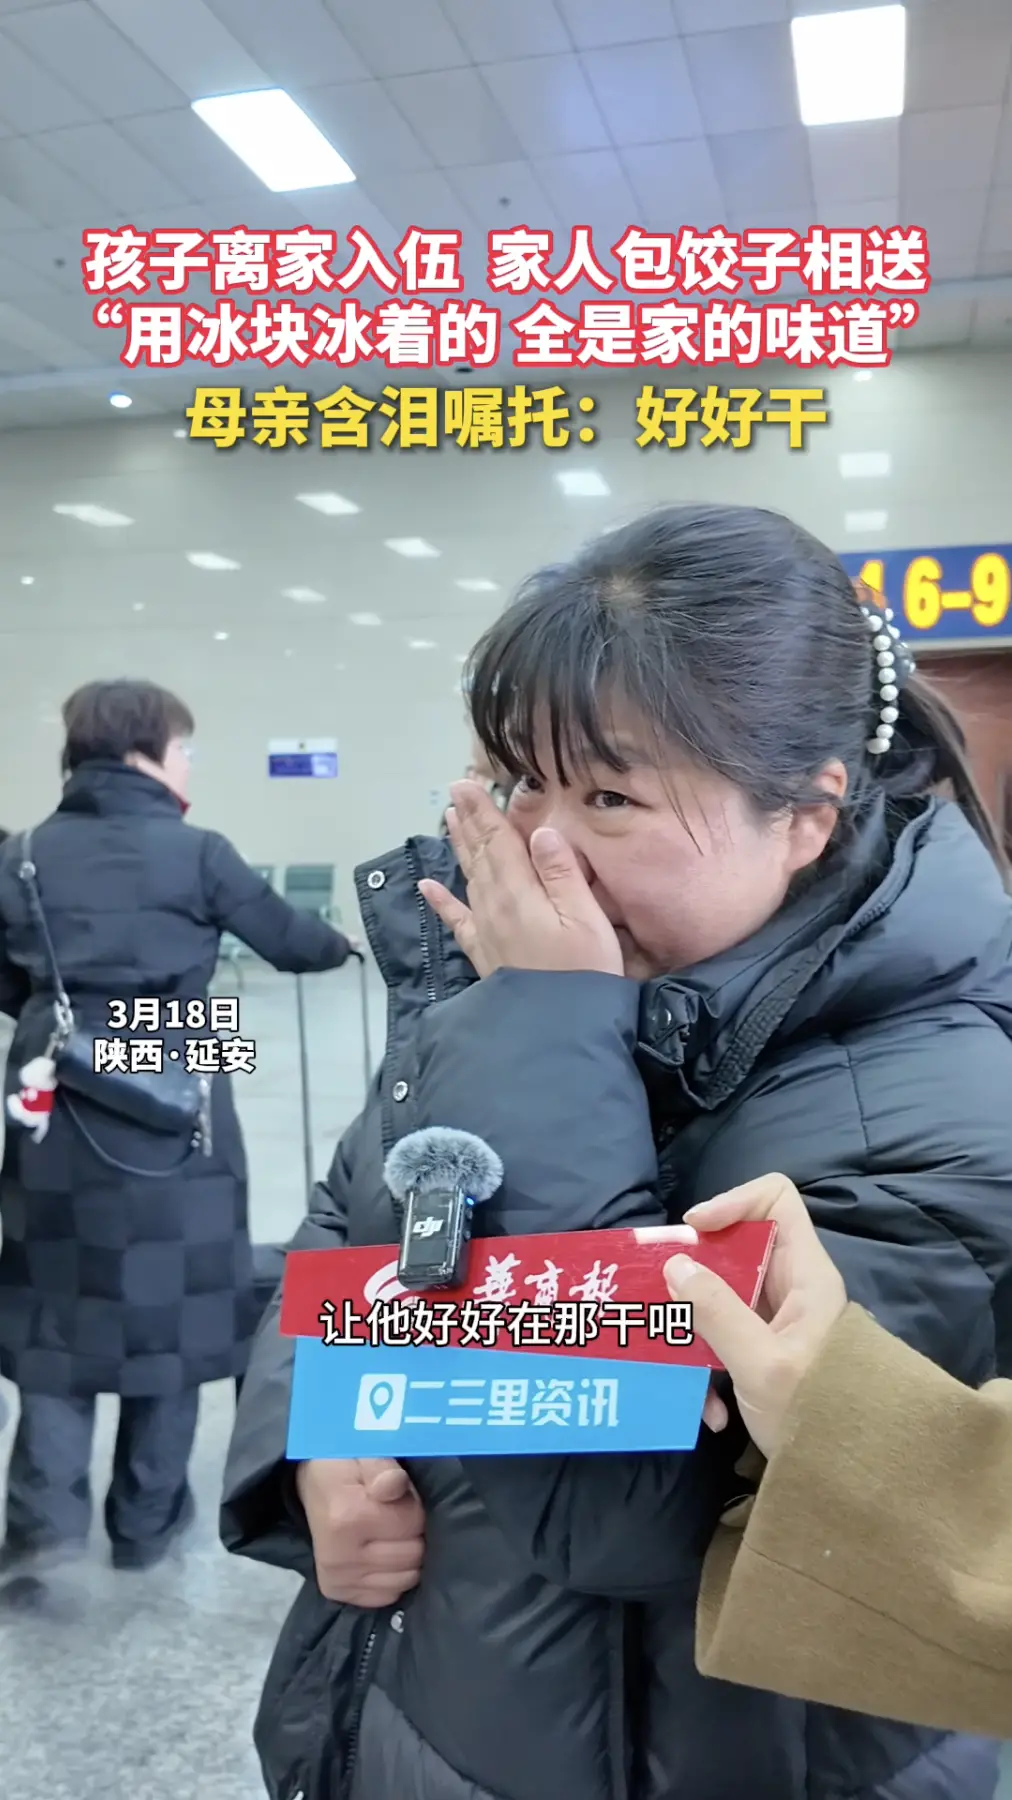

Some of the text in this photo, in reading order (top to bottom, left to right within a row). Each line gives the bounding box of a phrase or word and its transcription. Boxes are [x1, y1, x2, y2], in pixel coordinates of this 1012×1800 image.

[404, 1378, 619, 1427] 二三里资讯
